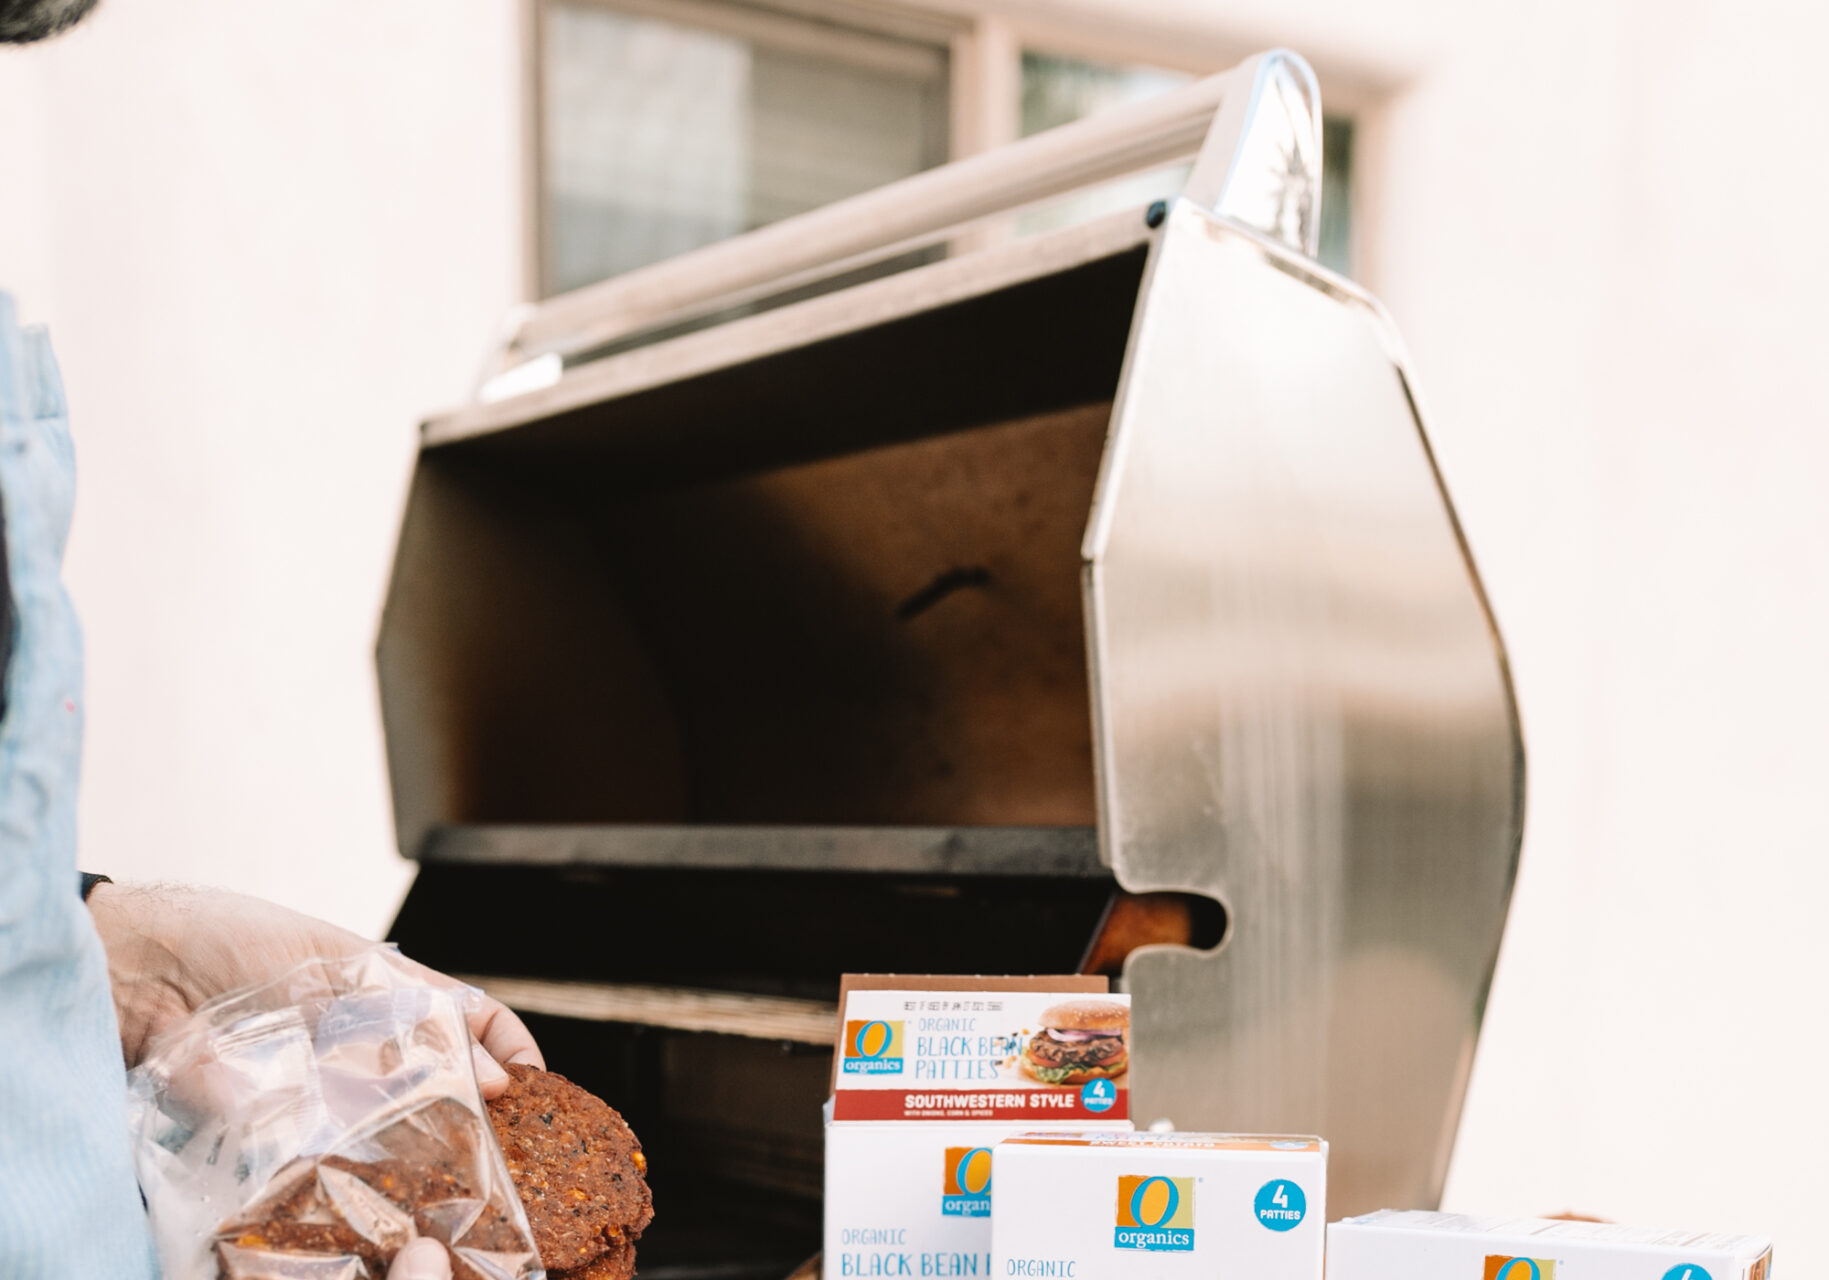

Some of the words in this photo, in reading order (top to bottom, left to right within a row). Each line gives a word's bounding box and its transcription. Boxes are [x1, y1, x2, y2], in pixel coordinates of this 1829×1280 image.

[919, 1018, 976, 1032] ORGANIC
[917, 1036, 973, 1056] BLACK
[979, 1037, 1023, 1056] BEAN
[845, 1059, 901, 1073] organics
[915, 1059, 999, 1080] PATTIES
[1093, 1081, 1105, 1097] 4
[904, 1094, 1025, 1108] SOUTHWESTERN
[1030, 1095, 1074, 1108] STYLE
[1130, 1176, 1179, 1228] O
[1272, 1185, 1288, 1208] 4
[1260, 1209, 1301, 1220] PATTIES
[842, 1228, 906, 1245] ORGANIC
[1118, 1231, 1190, 1248] organics
[842, 1253, 912, 1276] BLACK
[921, 1253, 977, 1276] BEAN
[1007, 1259, 1076, 1277] ORGANIC
